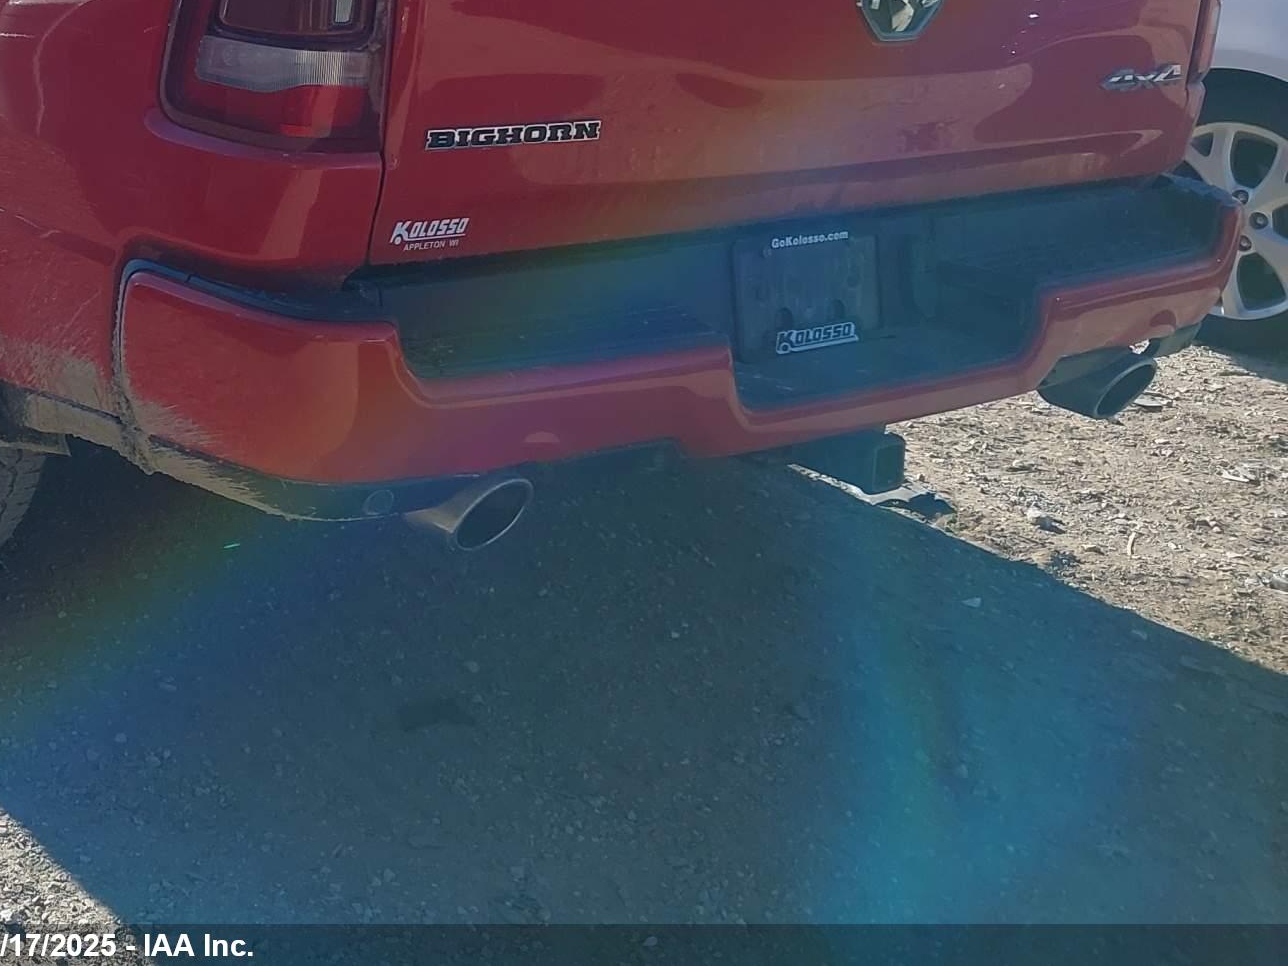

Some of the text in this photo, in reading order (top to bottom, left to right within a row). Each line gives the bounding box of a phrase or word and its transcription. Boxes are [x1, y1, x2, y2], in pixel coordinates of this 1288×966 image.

[425, 120, 601, 151] BIGHORN
[404, 239, 460, 251] APPLETON WI
[771, 231, 849, 249] GoKolosso.com
[776, 322, 858, 354] KOLOSSO
